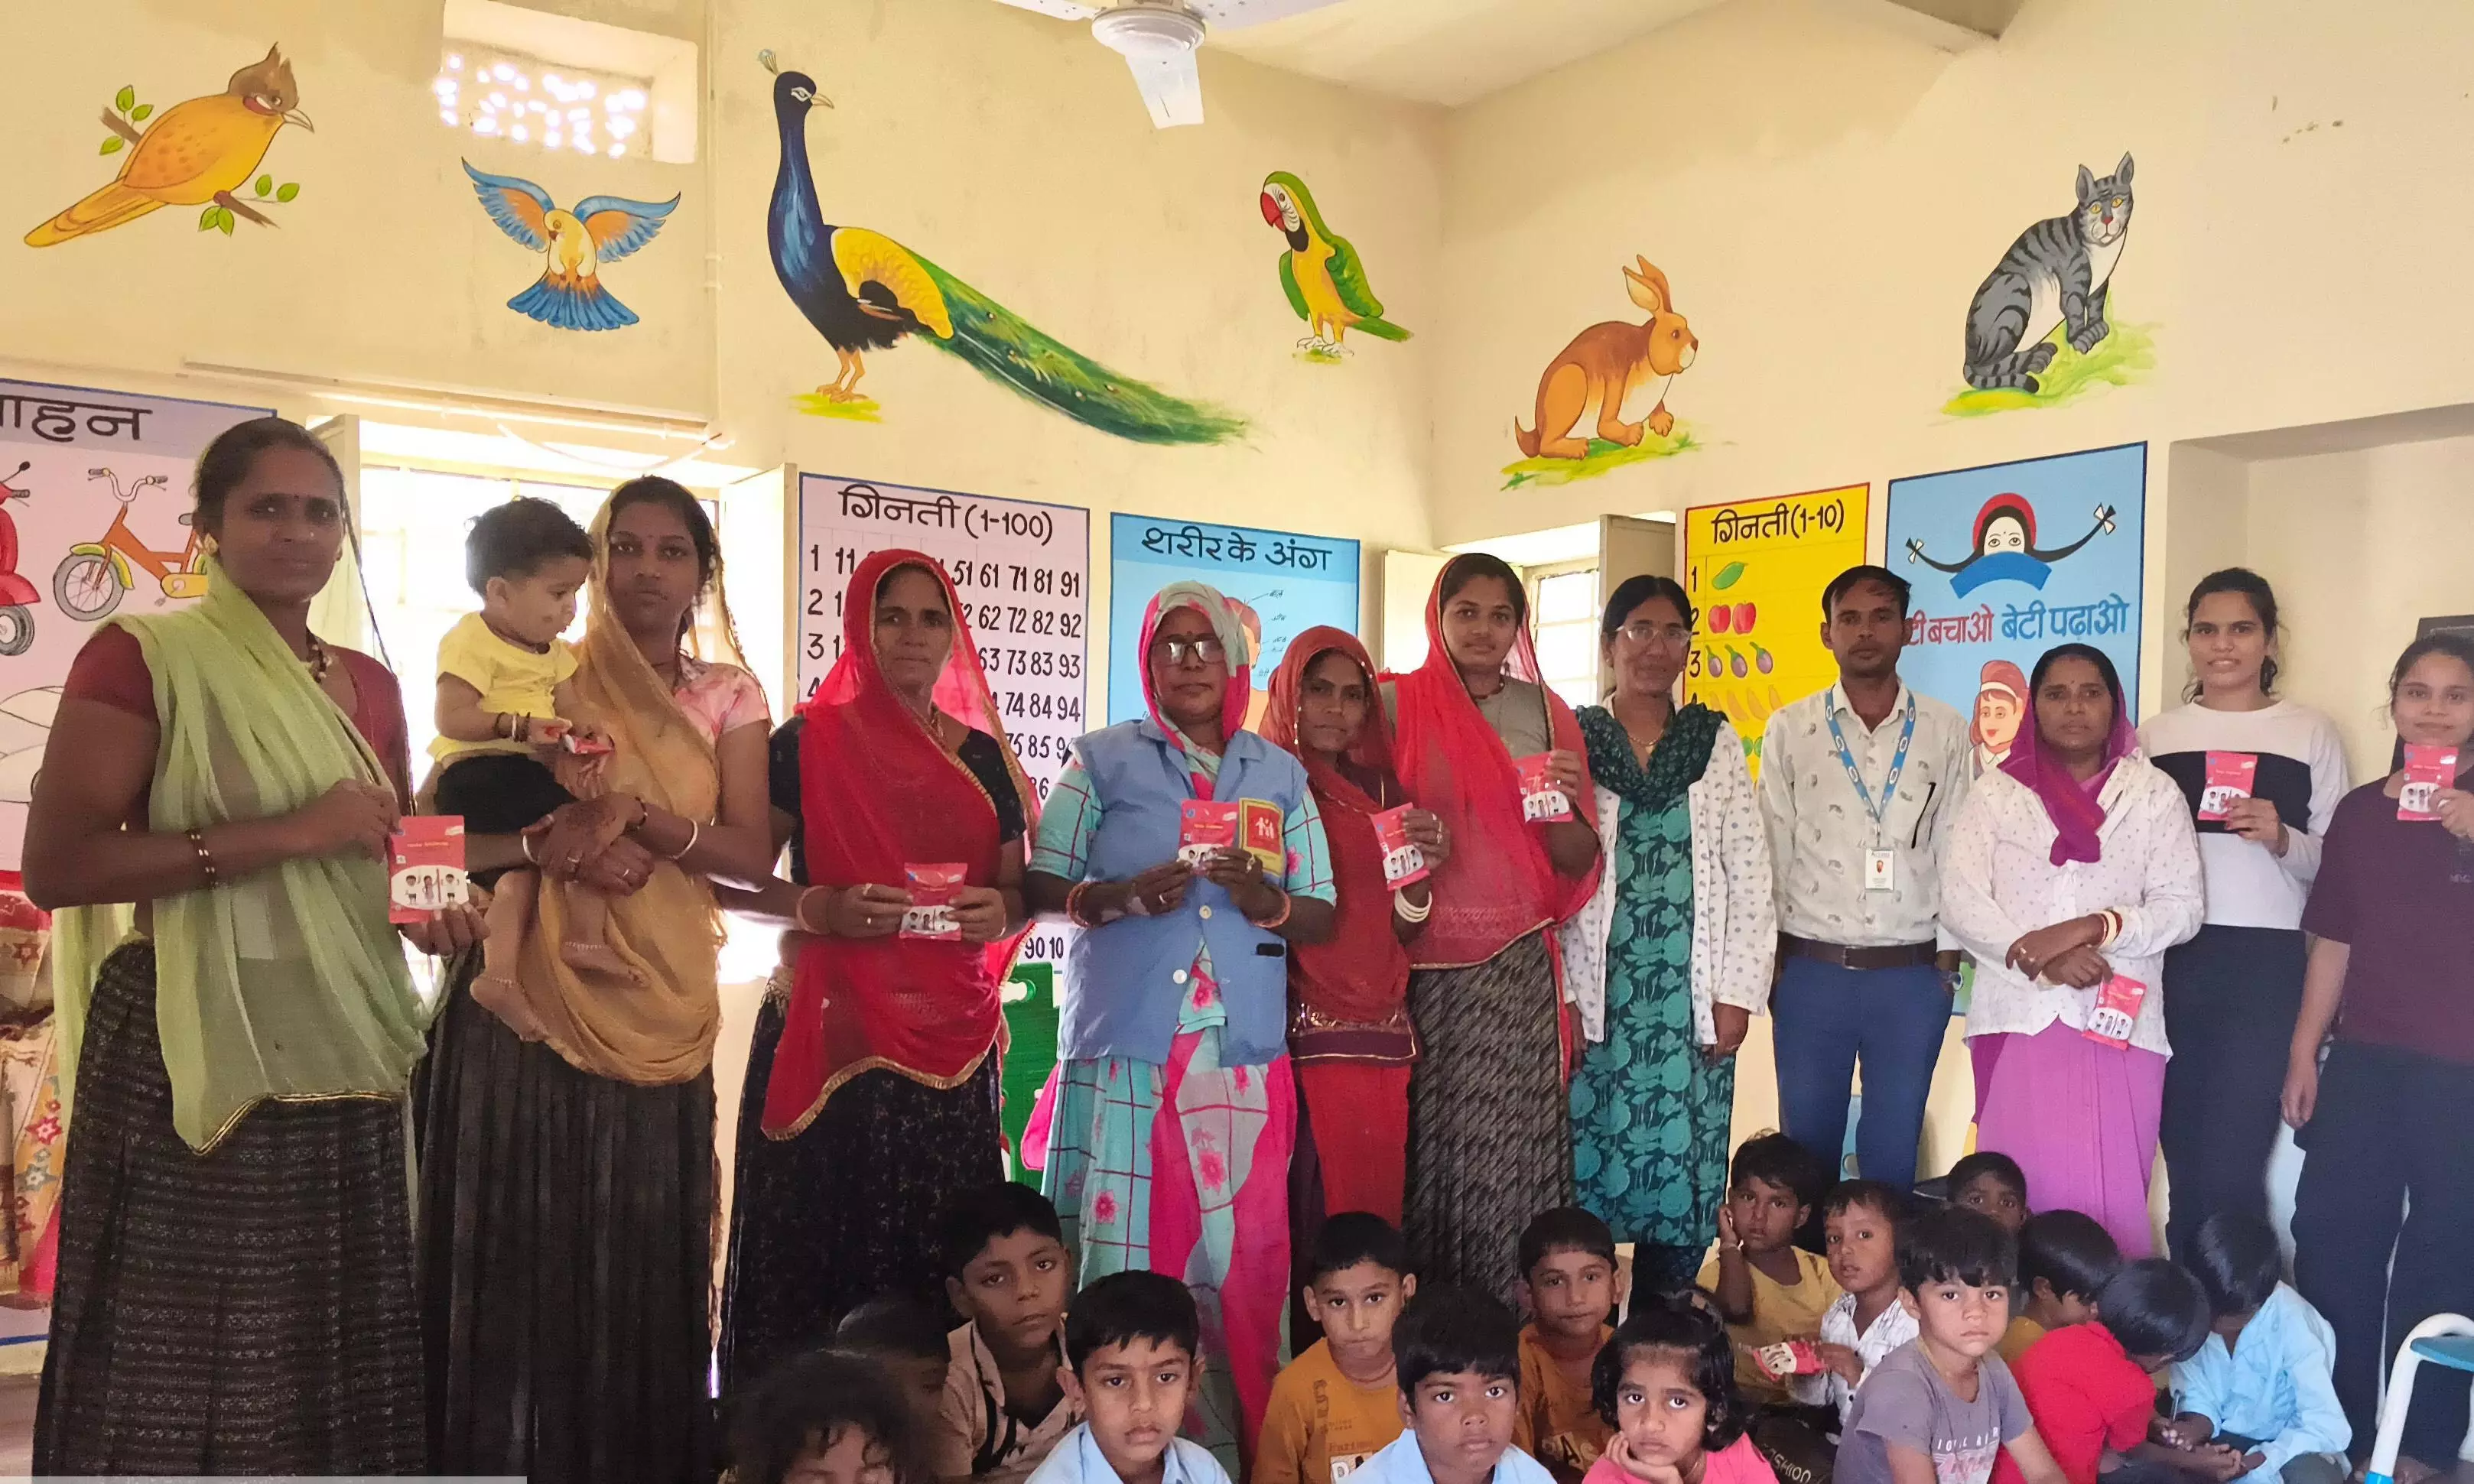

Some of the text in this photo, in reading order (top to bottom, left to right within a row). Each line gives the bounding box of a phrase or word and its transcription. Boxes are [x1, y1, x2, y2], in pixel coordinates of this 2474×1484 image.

[964, 505, 1053, 547] (1-100)
[1791, 498, 1845, 539] (1-10)
[1142, 526, 1223, 561] शरीर
[1265, 538, 1332, 571] अंग
[811, 544, 818, 572] 1
[835, 547, 855, 574] 11
[951, 560, 973, 586] 51
[980, 563, 999, 589] 61
[1008, 565, 1027, 593] 71
[1033, 568, 1053, 595] 81
[1060, 570, 1080, 598] 91
[1691, 566, 1698, 593] 1
[808, 589, 824, 615] 2
[978, 605, 1001, 631] 62
[1007, 606, 1027, 634] 72
[1032, 609, 1054, 635] 82
[1060, 612, 1081, 638] 92
[1927, 603, 1994, 644] बचाओ
[2001, 599, 2046, 640] बेटी
[807, 632, 824, 660] 3
[978, 647, 1000, 672] 63
[1006, 649, 1026, 676] 73
[1030, 651, 1053, 677] 83
[1059, 654, 1081, 679] 93
[1689, 651, 1701, 678] 3
[1005, 691, 1026, 718] 74
[1029, 693, 1053, 719] 84
[1057, 696, 1081, 723] 94
[1028, 734, 1052, 758] 85
[1025, 937, 1045, 960] 90
